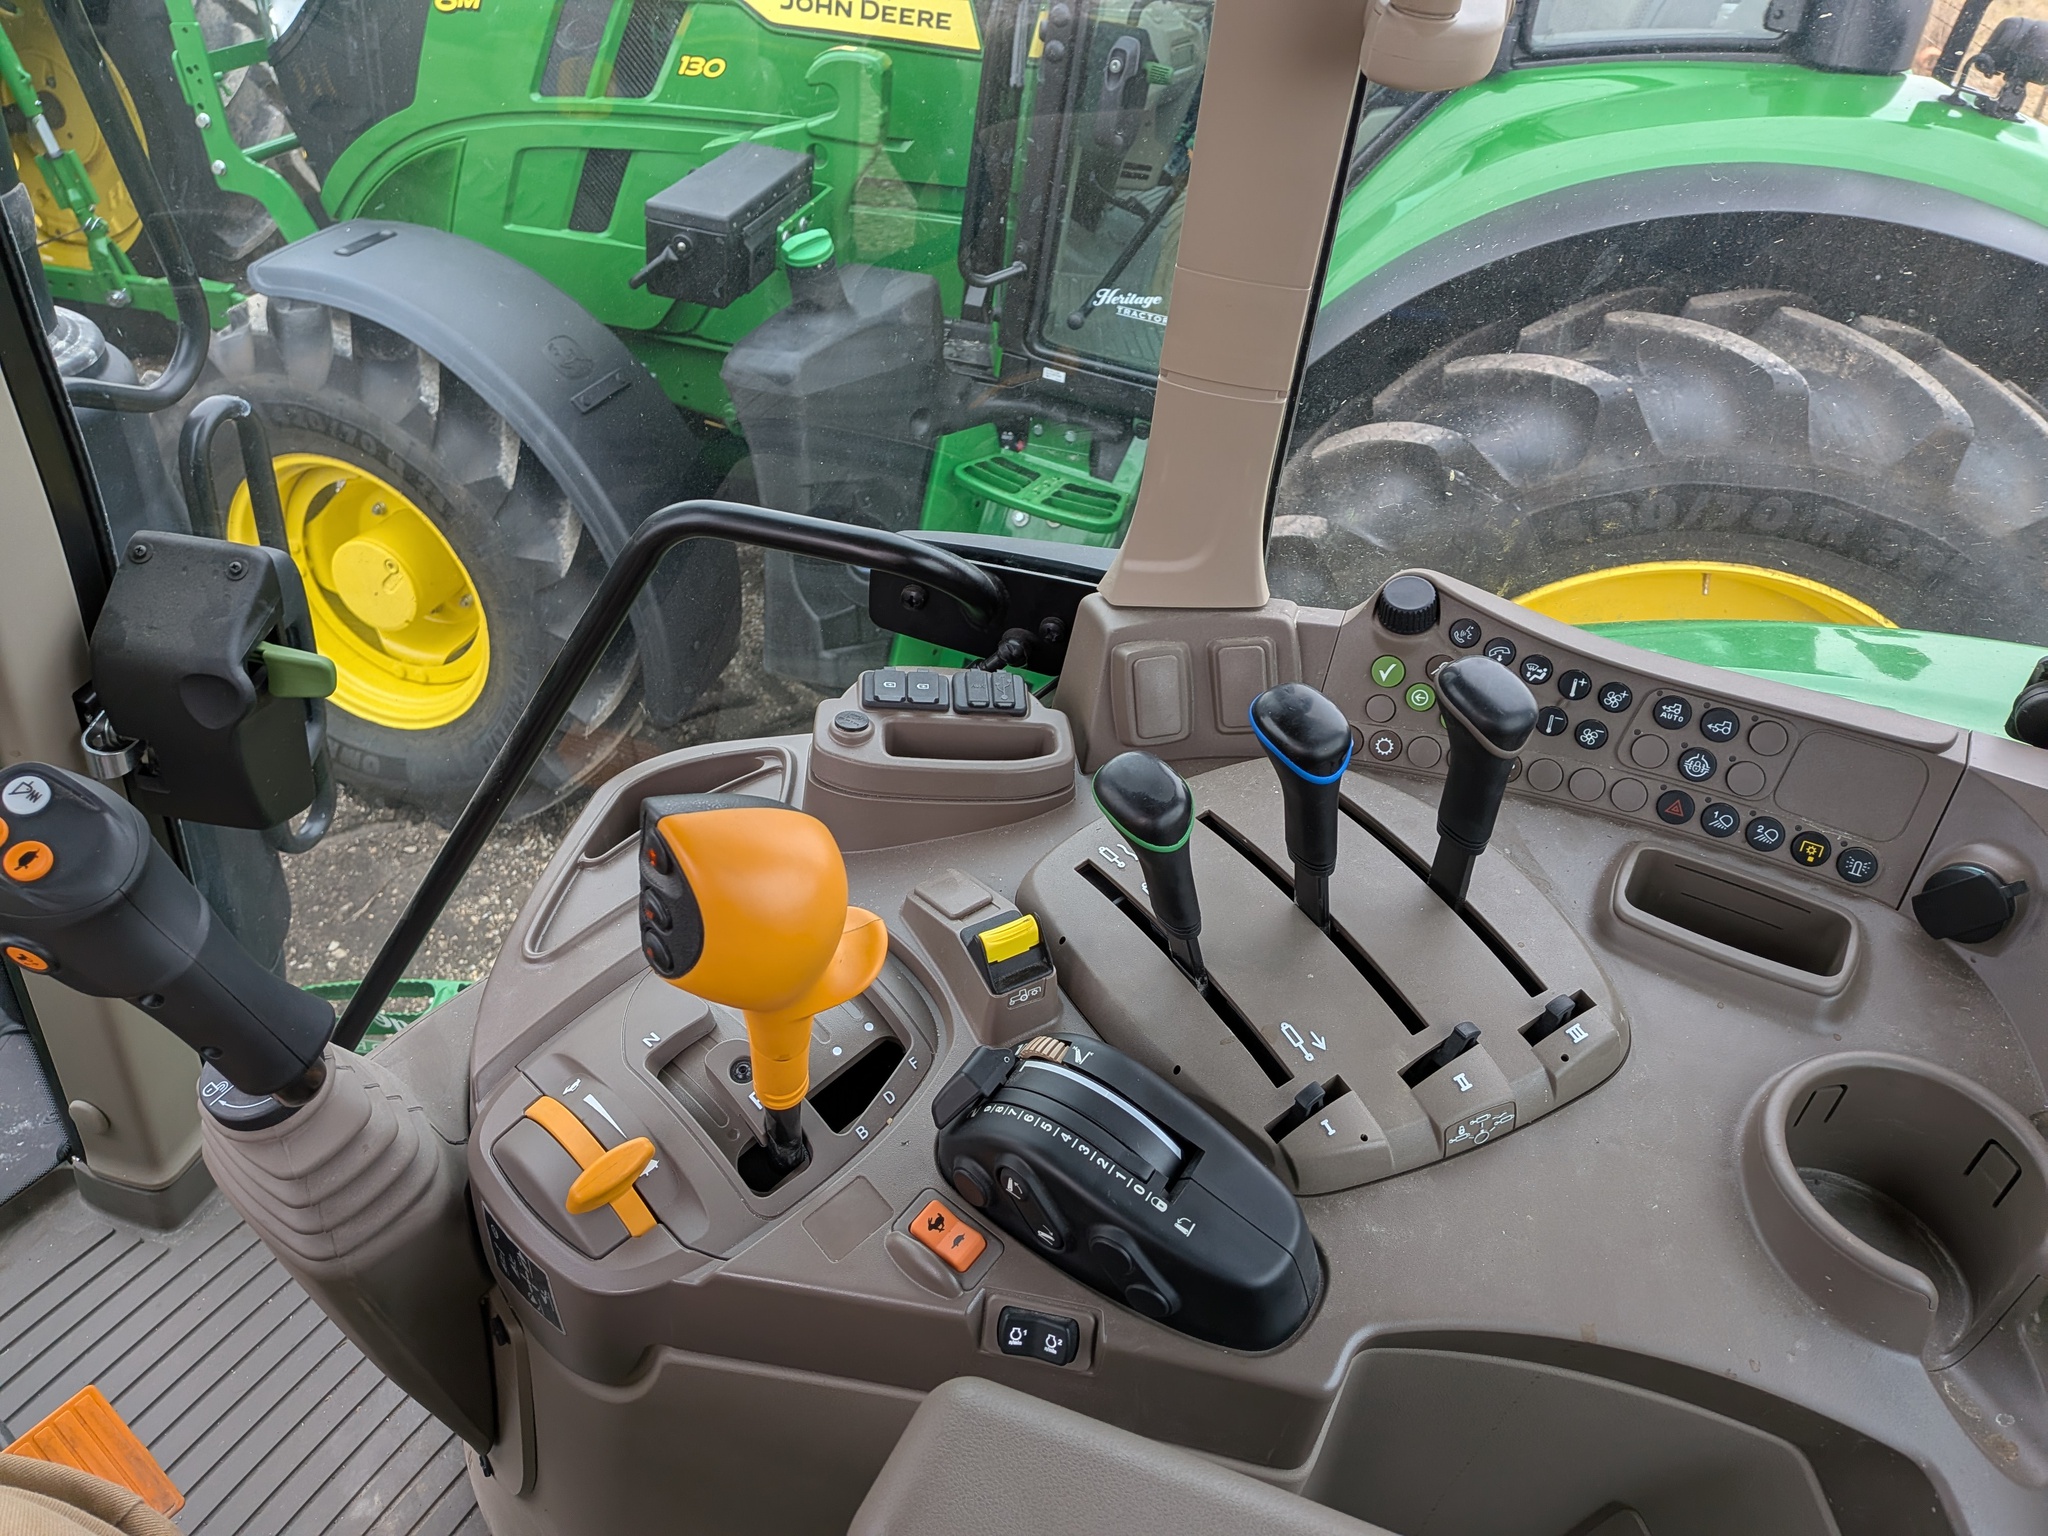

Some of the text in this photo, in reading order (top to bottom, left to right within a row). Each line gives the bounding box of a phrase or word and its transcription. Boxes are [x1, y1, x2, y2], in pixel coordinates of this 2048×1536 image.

[860, 0, 952, 31] DEERE
[677, 54, 727, 79] 130
[1092, 288, 1163, 309] Heritage
[1660, 711, 1684, 723] AUTO
[1713, 810, 1719, 819] 1
[1757, 825, 1764, 834] 2
[642, 1031, 661, 1048] N
[1565, 1022, 1589, 1044] III
[907, 1056, 919, 1070] F
[882, 1090, 896, 1105] D
[855, 1125, 870, 1141] B
[1008, 1109, 1018, 1117] 7
[1023, 1113, 1034, 1123] 6
[1040, 1121, 1052, 1132] 5
[1061, 1132, 1072, 1143] 4
[1078, 1144, 1090, 1155] 3
[1096, 1157, 1110, 1170] 2
[1115, 1170, 1127, 1181] 1
[1133, 1185, 1146, 1195] 0
[1058, 1338, 1063, 1346] 2
